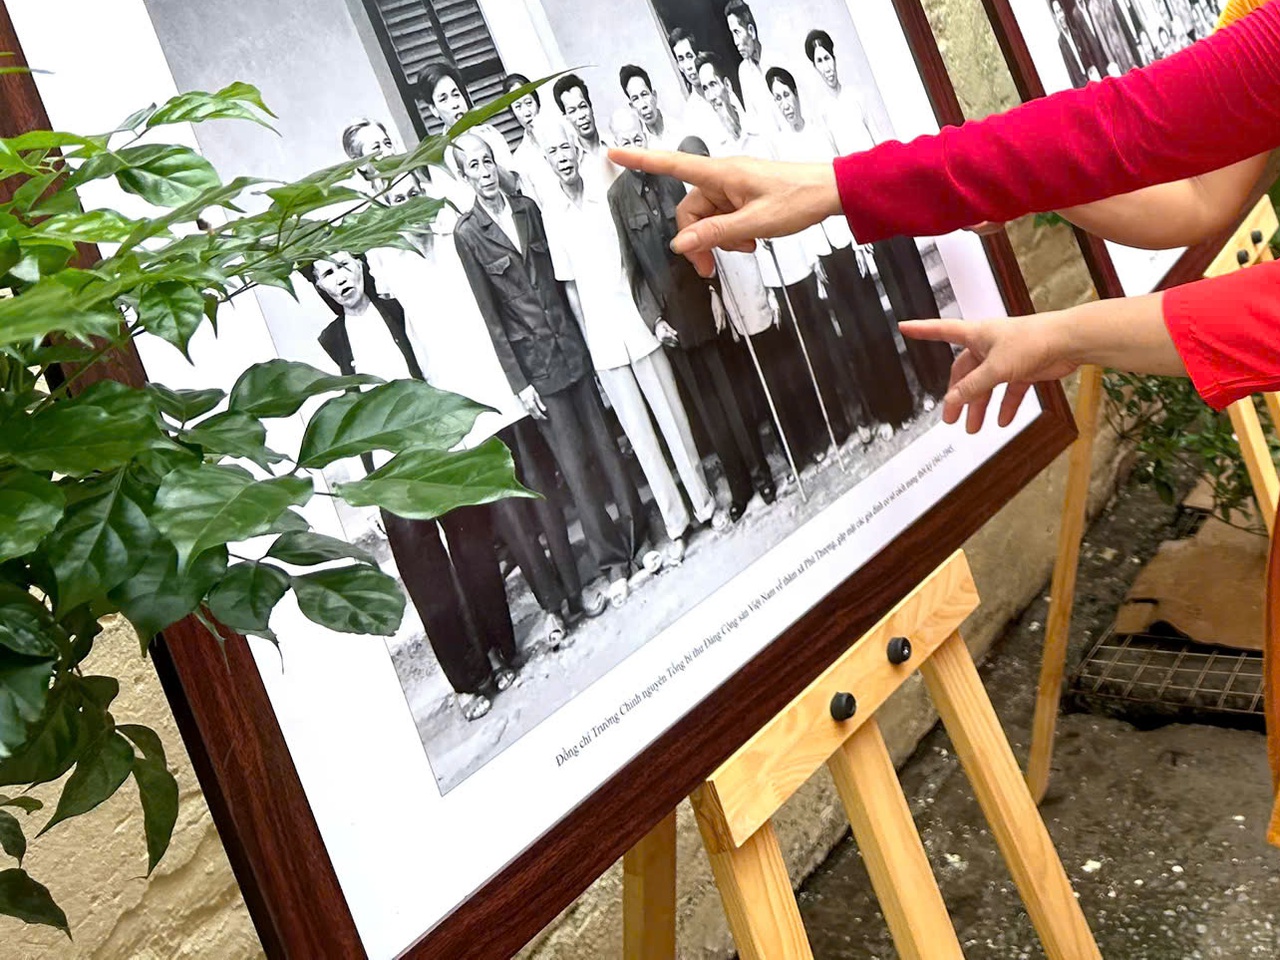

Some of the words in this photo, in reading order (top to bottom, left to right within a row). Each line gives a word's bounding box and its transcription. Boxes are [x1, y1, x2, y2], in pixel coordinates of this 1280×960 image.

[555, 747, 580, 767] Đồng
[579, 731, 592, 749] chí
[590, 712, 620, 738] Trường
[619, 692, 642, 716] Chinh
[641, 674, 668, 700] nguyên
[666, 661, 686, 678] Tổng
[692, 644, 704, 658] thư
[702, 631, 722, 649] Đảng
[720, 618, 739, 636] Cộng
[748, 599, 762, 612] Việt
[760, 587, 777, 603] Nam
